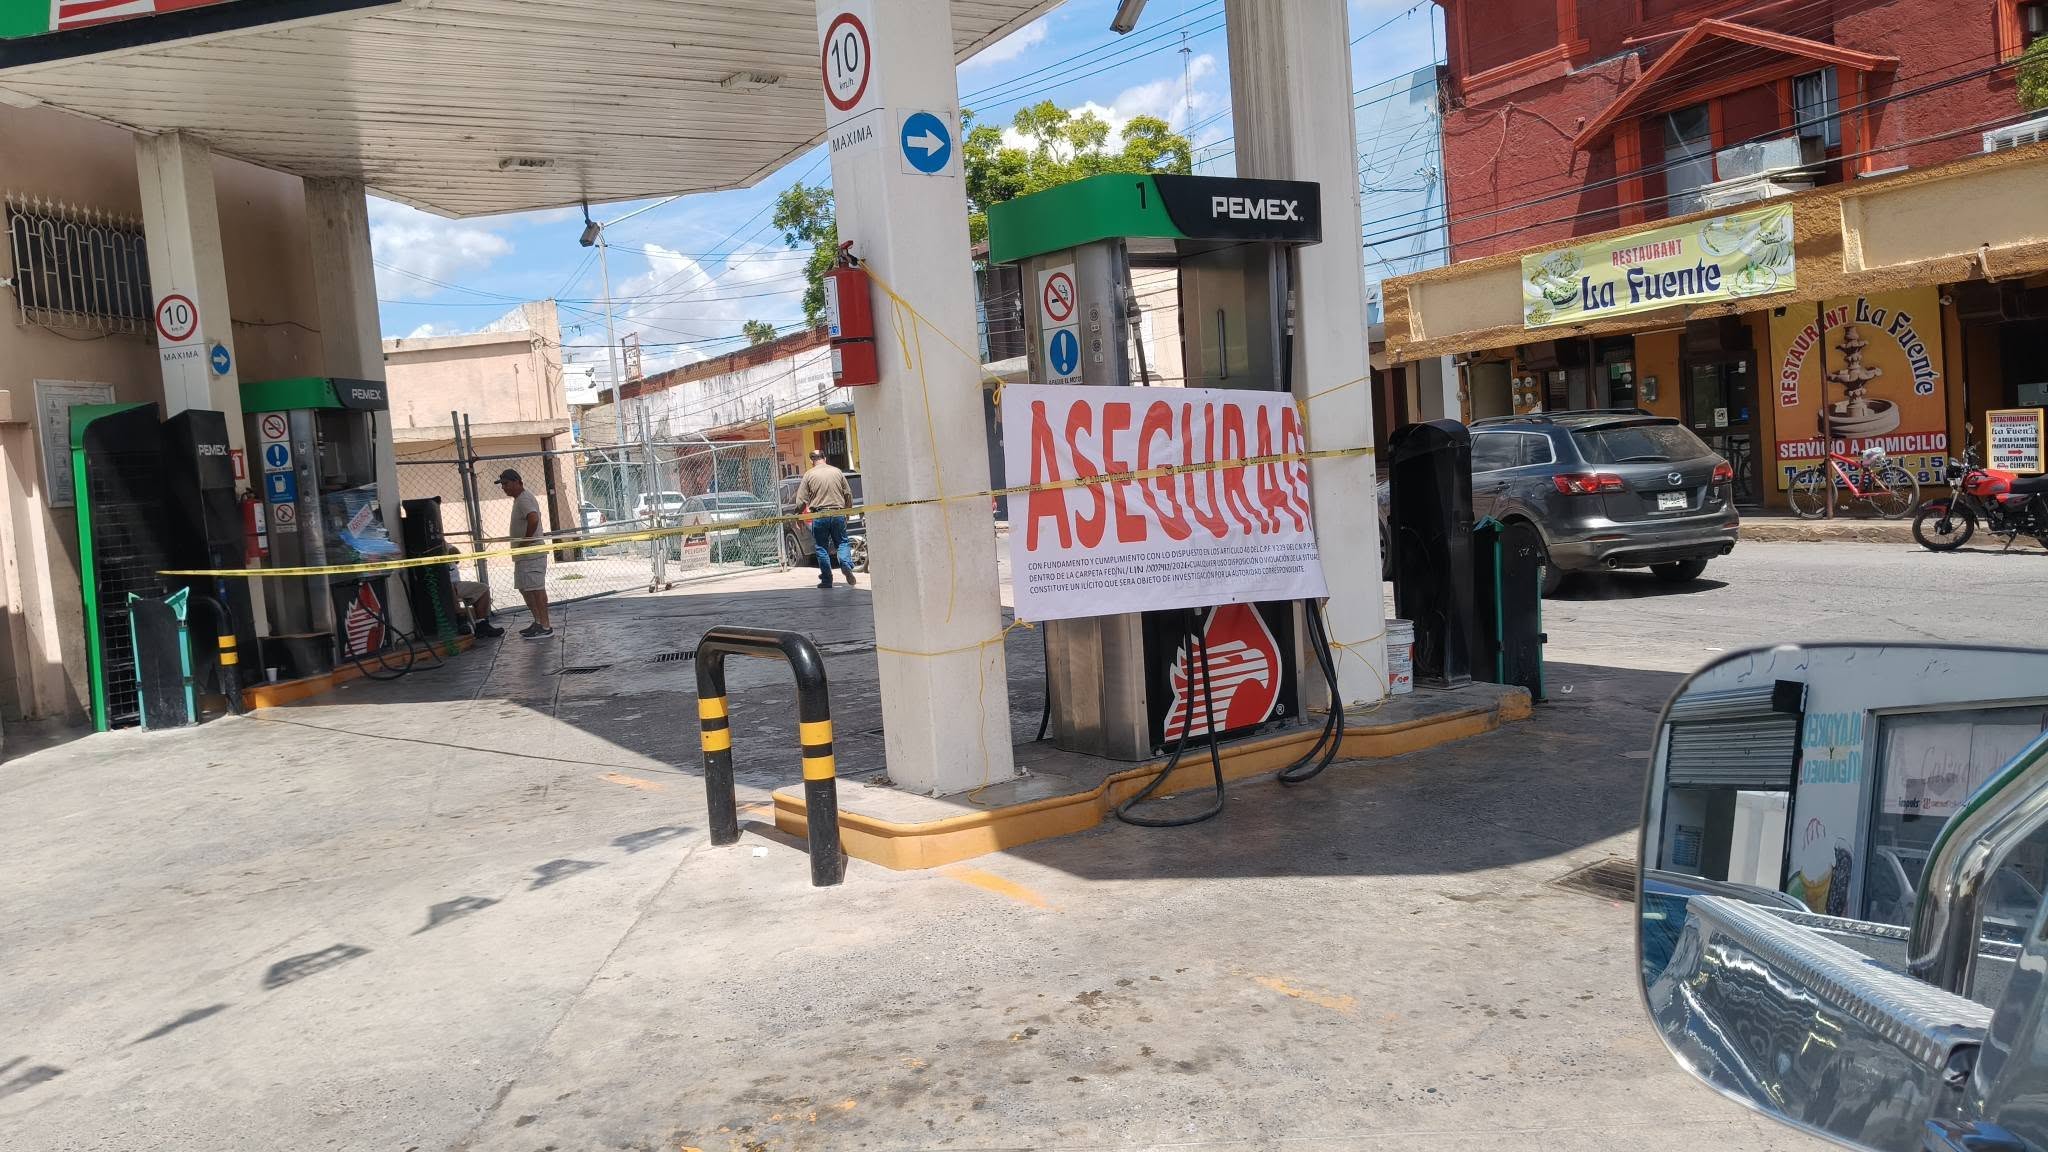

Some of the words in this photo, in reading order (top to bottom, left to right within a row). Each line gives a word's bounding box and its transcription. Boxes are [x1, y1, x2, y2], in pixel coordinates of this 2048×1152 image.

[831, 32, 859, 78] 10
[832, 125, 873, 153] MAXIMA
[1135, 181, 1147, 209] 1
[1212, 196, 1299, 221] PEMEX
[1612, 239, 1683, 267] RESTAURANT
[1582, 275, 1616, 311] La
[1627, 257, 1721, 304] Fuente
[164, 304, 188, 326] 10
[164, 350, 199, 362] MAXIMA
[1855, 297, 1887, 326] La
[1887, 310, 1940, 395] Fuente
[352, 388, 381, 400] PEMEX
[198, 444, 228, 456] PEMEX
[1850, 438, 1860, 454] A
[1864, 433, 1947, 450] DOMICILIO
[1028, 562, 1042, 571] CON
[1043, 558, 1089, 569] FUNDAMENTO
[1095, 553, 1145, 564] CUMPLIMIENTO
[1147, 552, 1161, 560] CON
[1162, 551, 1170, 559] LO
[1172, 548, 1202, 558] DISPUESTO
[1211, 547, 1219, 555] LOS
[1030, 572, 1055, 582] DENTRO
[1057, 572, 1065, 580] DE
[1067, 571, 1074, 579] LA
[1076, 568, 1102, 578] CARPETA
[1030, 582, 1068, 594] CONSTITUYE
[1070, 581, 1080, 590] UN
[1104, 579, 1118, 588] QUE
[1120, 577, 1135, 586] SERA
[1137, 576, 1160, 585] OBJETO
[1215, 570, 1225, 579] POR
[1226, 569, 1232, 578] LA
[1232, 568, 1262, 577] AUTORIDAD
[1262, 565, 1304, 575] CORRESPONDIENTE
